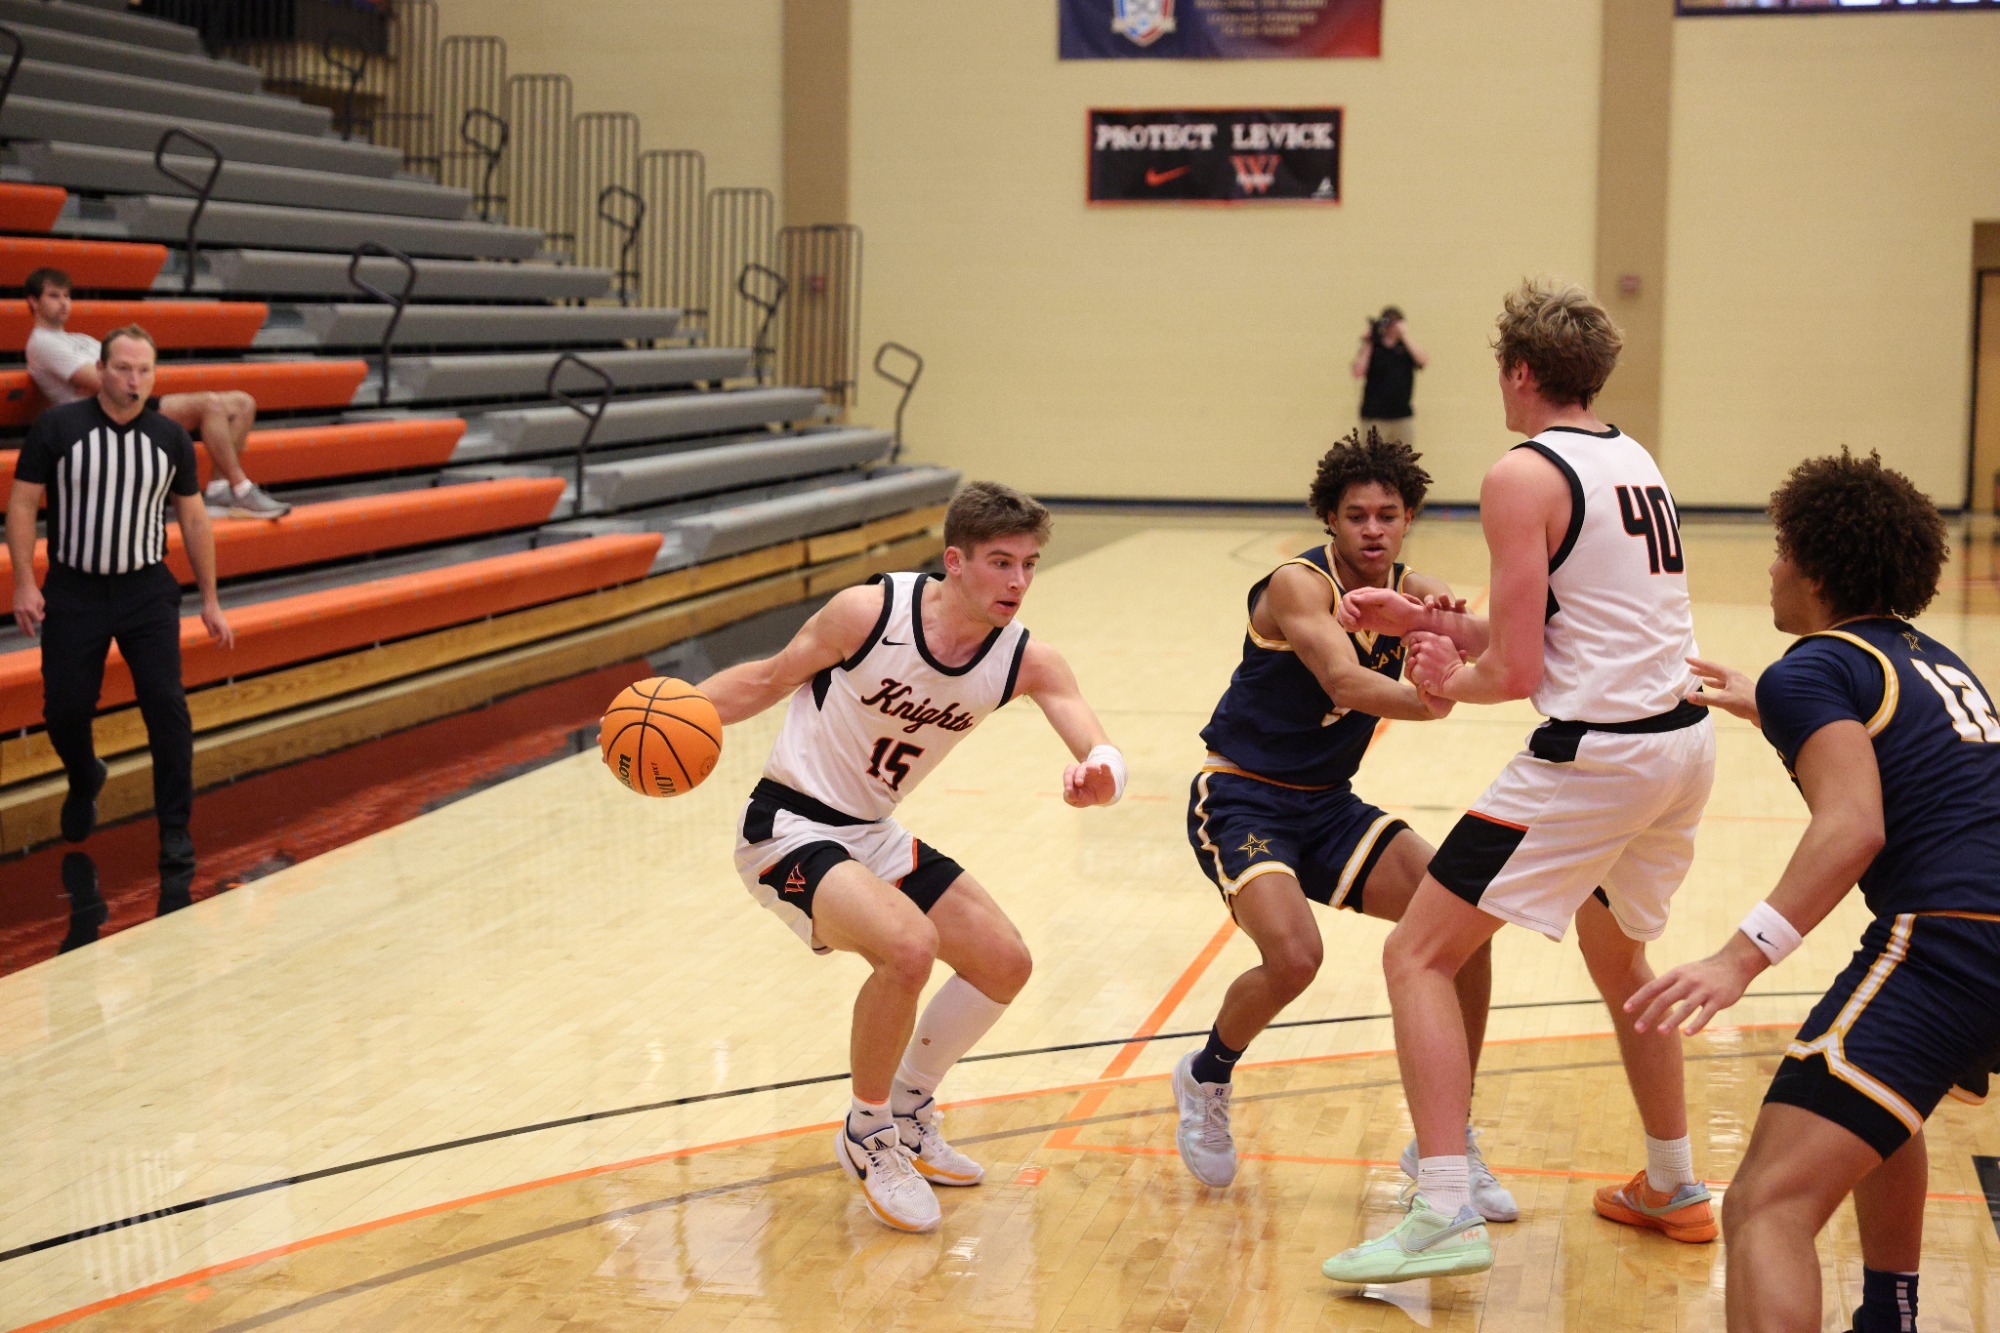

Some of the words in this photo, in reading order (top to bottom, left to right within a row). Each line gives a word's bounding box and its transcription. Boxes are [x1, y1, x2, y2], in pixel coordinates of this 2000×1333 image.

[1095, 123, 1218, 150] PROTECT
[1231, 122, 1336, 149] LEVICK
[1614, 485, 1684, 575] 40
[861, 678, 974, 733] Knights
[1910, 658, 2000, 743] 12
[866, 737, 925, 792] 15
